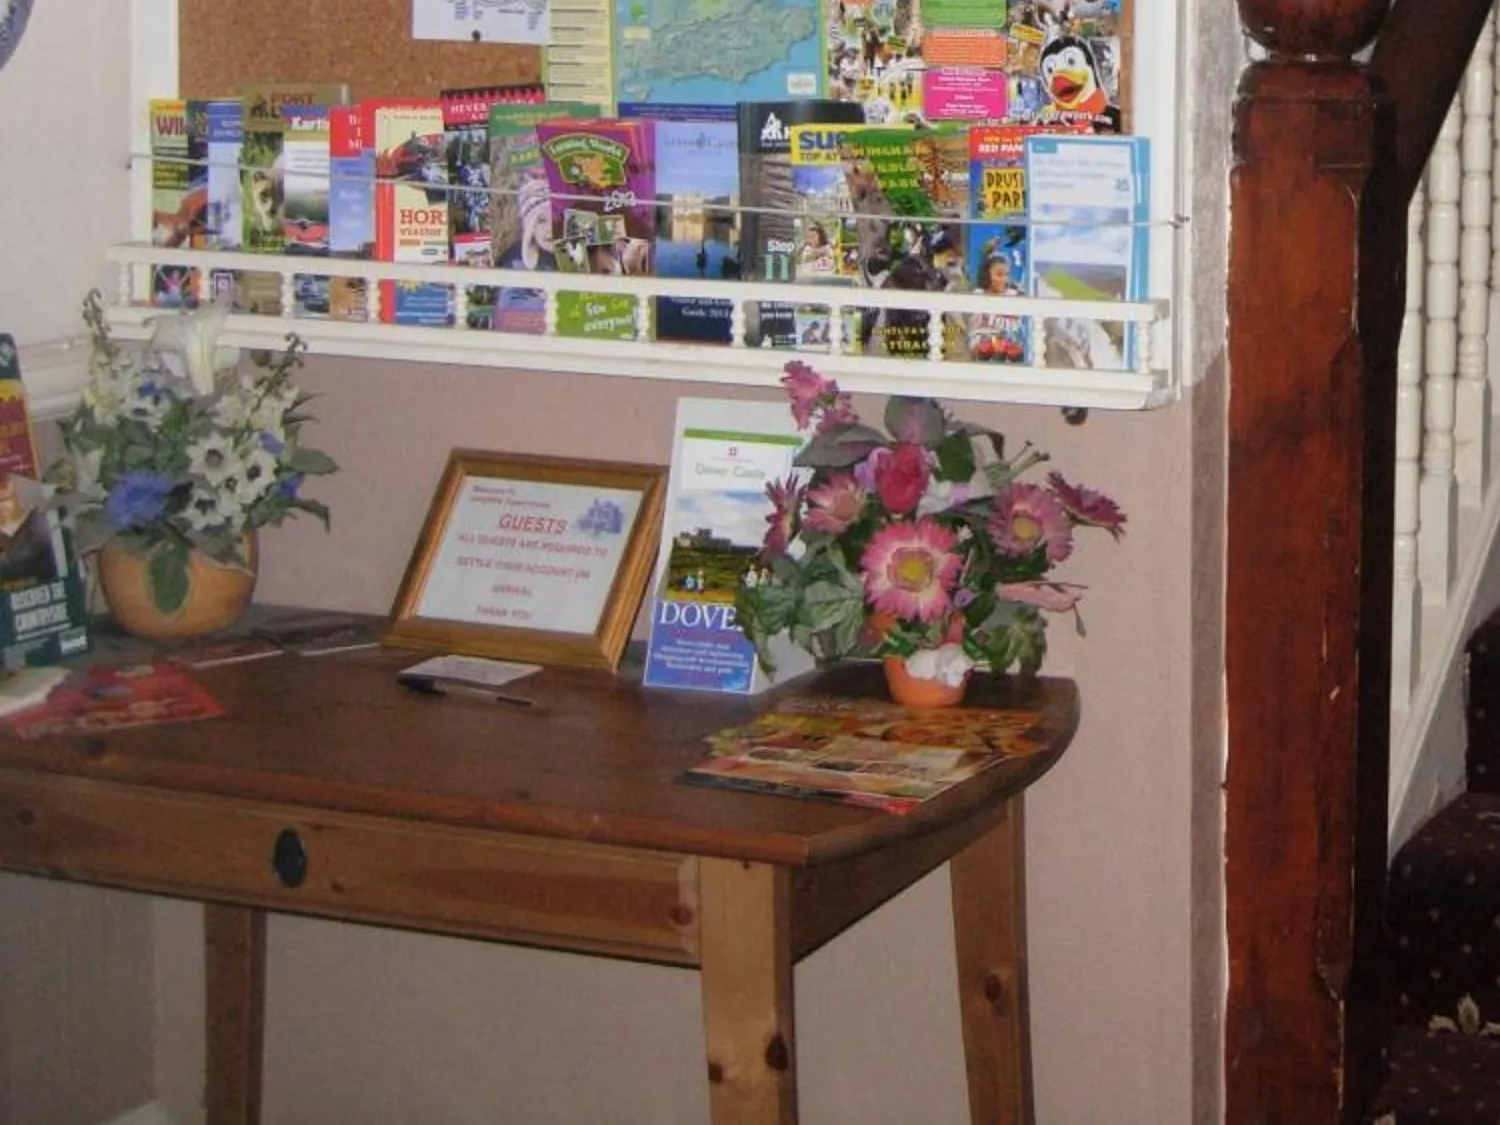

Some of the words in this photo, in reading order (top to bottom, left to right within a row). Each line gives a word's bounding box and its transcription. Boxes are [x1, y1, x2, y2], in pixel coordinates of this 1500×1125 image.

[400, 209, 447, 225] HOR
[499, 513, 568, 536] GUESTS
[659, 601, 744, 631] DOVE
